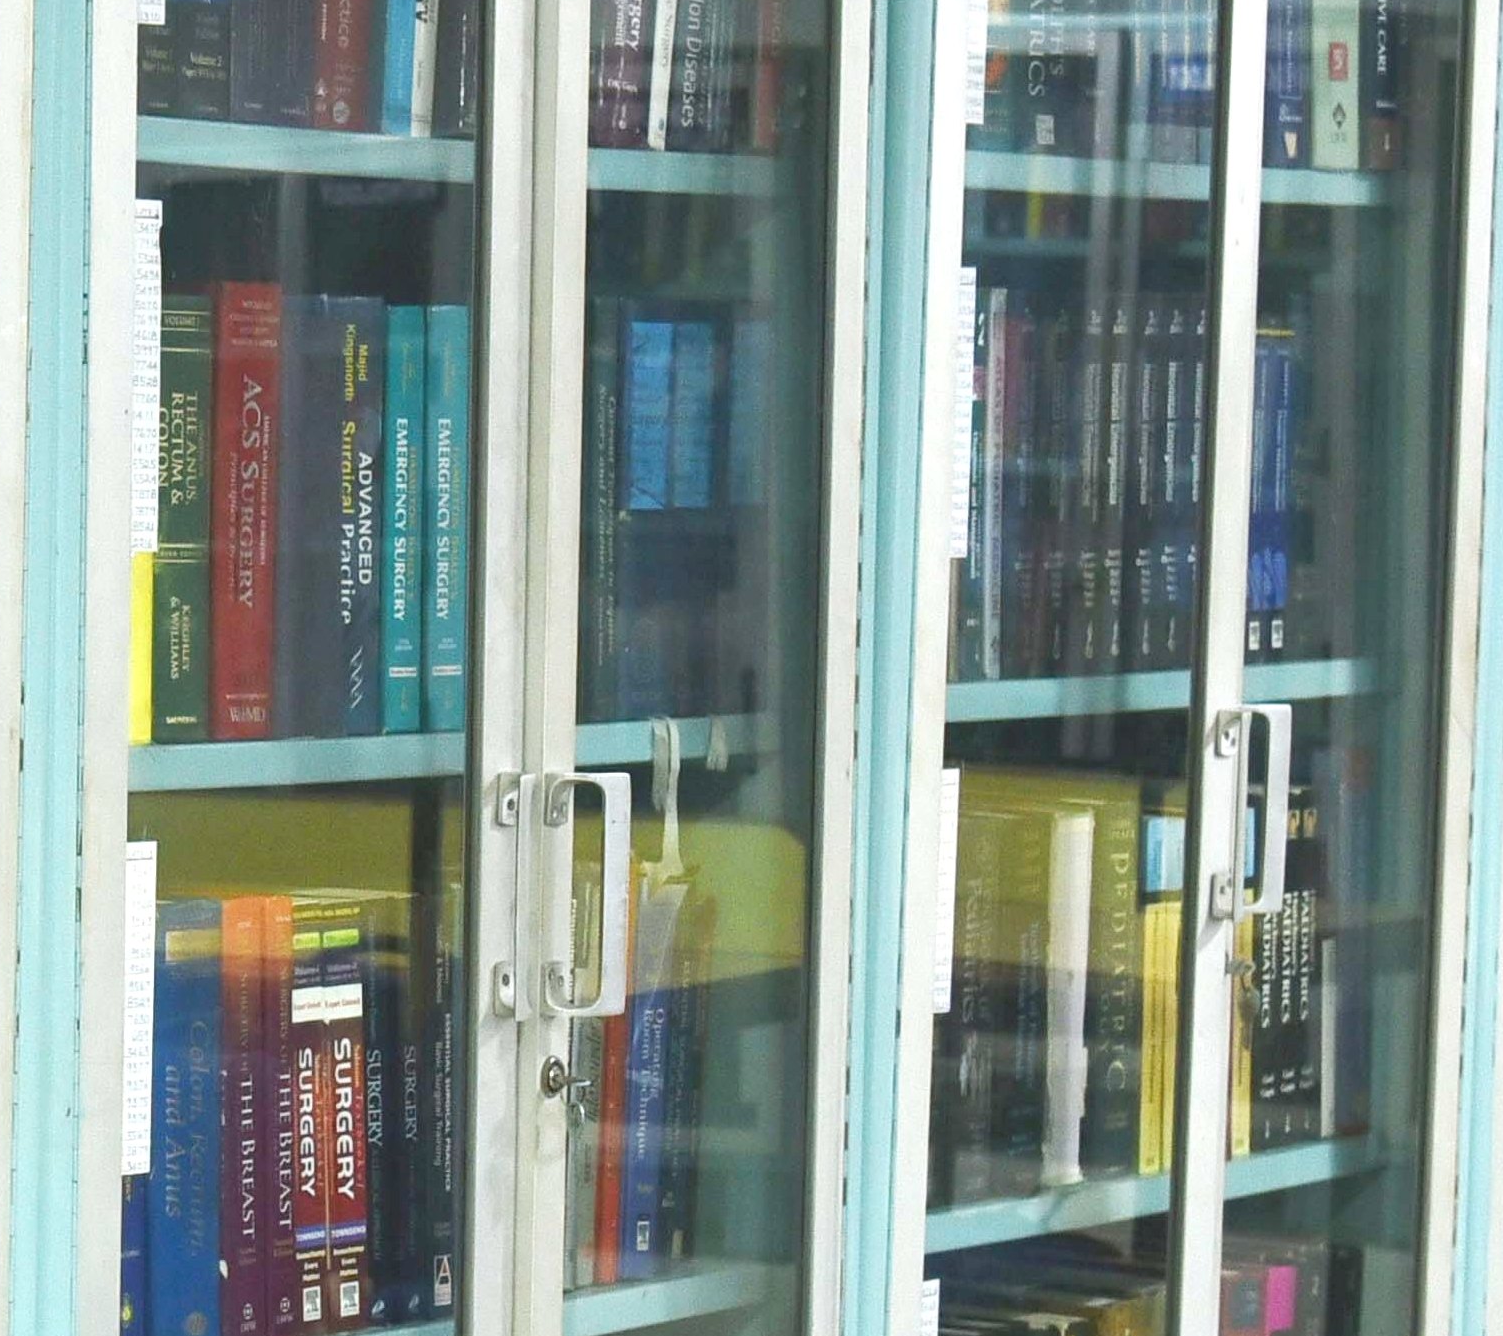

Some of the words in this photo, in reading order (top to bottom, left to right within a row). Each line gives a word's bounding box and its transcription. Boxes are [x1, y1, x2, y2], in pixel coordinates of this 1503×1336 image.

[241, 373, 262, 450] ACS
[394, 417, 408, 529] EMERGENCY
[238, 460, 260, 611] SURGERY
[358, 451, 373, 586] ADVANCED
[393, 536, 407, 621] SURGERY
[297, 1046, 316, 1198] SURGERY
[333, 1036, 355, 1202] SURGERY
